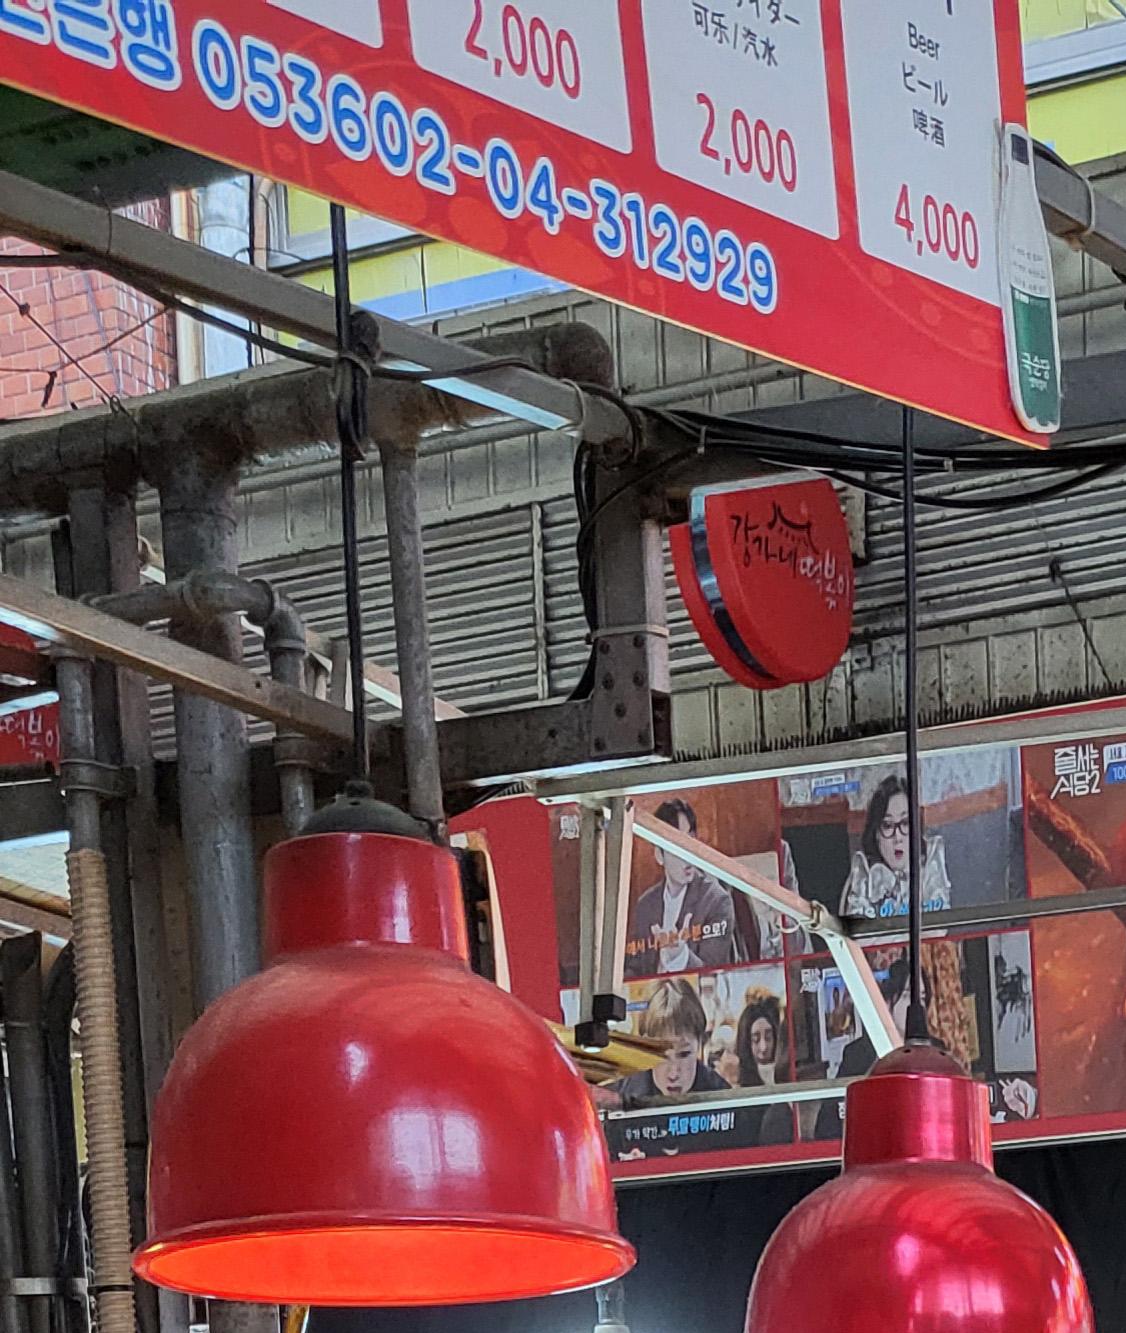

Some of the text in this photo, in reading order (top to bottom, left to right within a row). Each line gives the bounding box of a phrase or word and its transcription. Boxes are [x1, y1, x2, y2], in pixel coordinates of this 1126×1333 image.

[464, 0, 582, 99] 2,000
[907, 22, 941, 60] Beer
[902, 64, 949, 106] ビール
[696, 92, 797, 192] 2,000
[912, 109, 946, 148] 啤酒
[192, 19, 778, 315] 053602-04-312929
[894, 184, 980, 270] 4,000
[1053, 743, 1100, 776] 줄서는
[1050, 770, 1101, 800] 식당2
